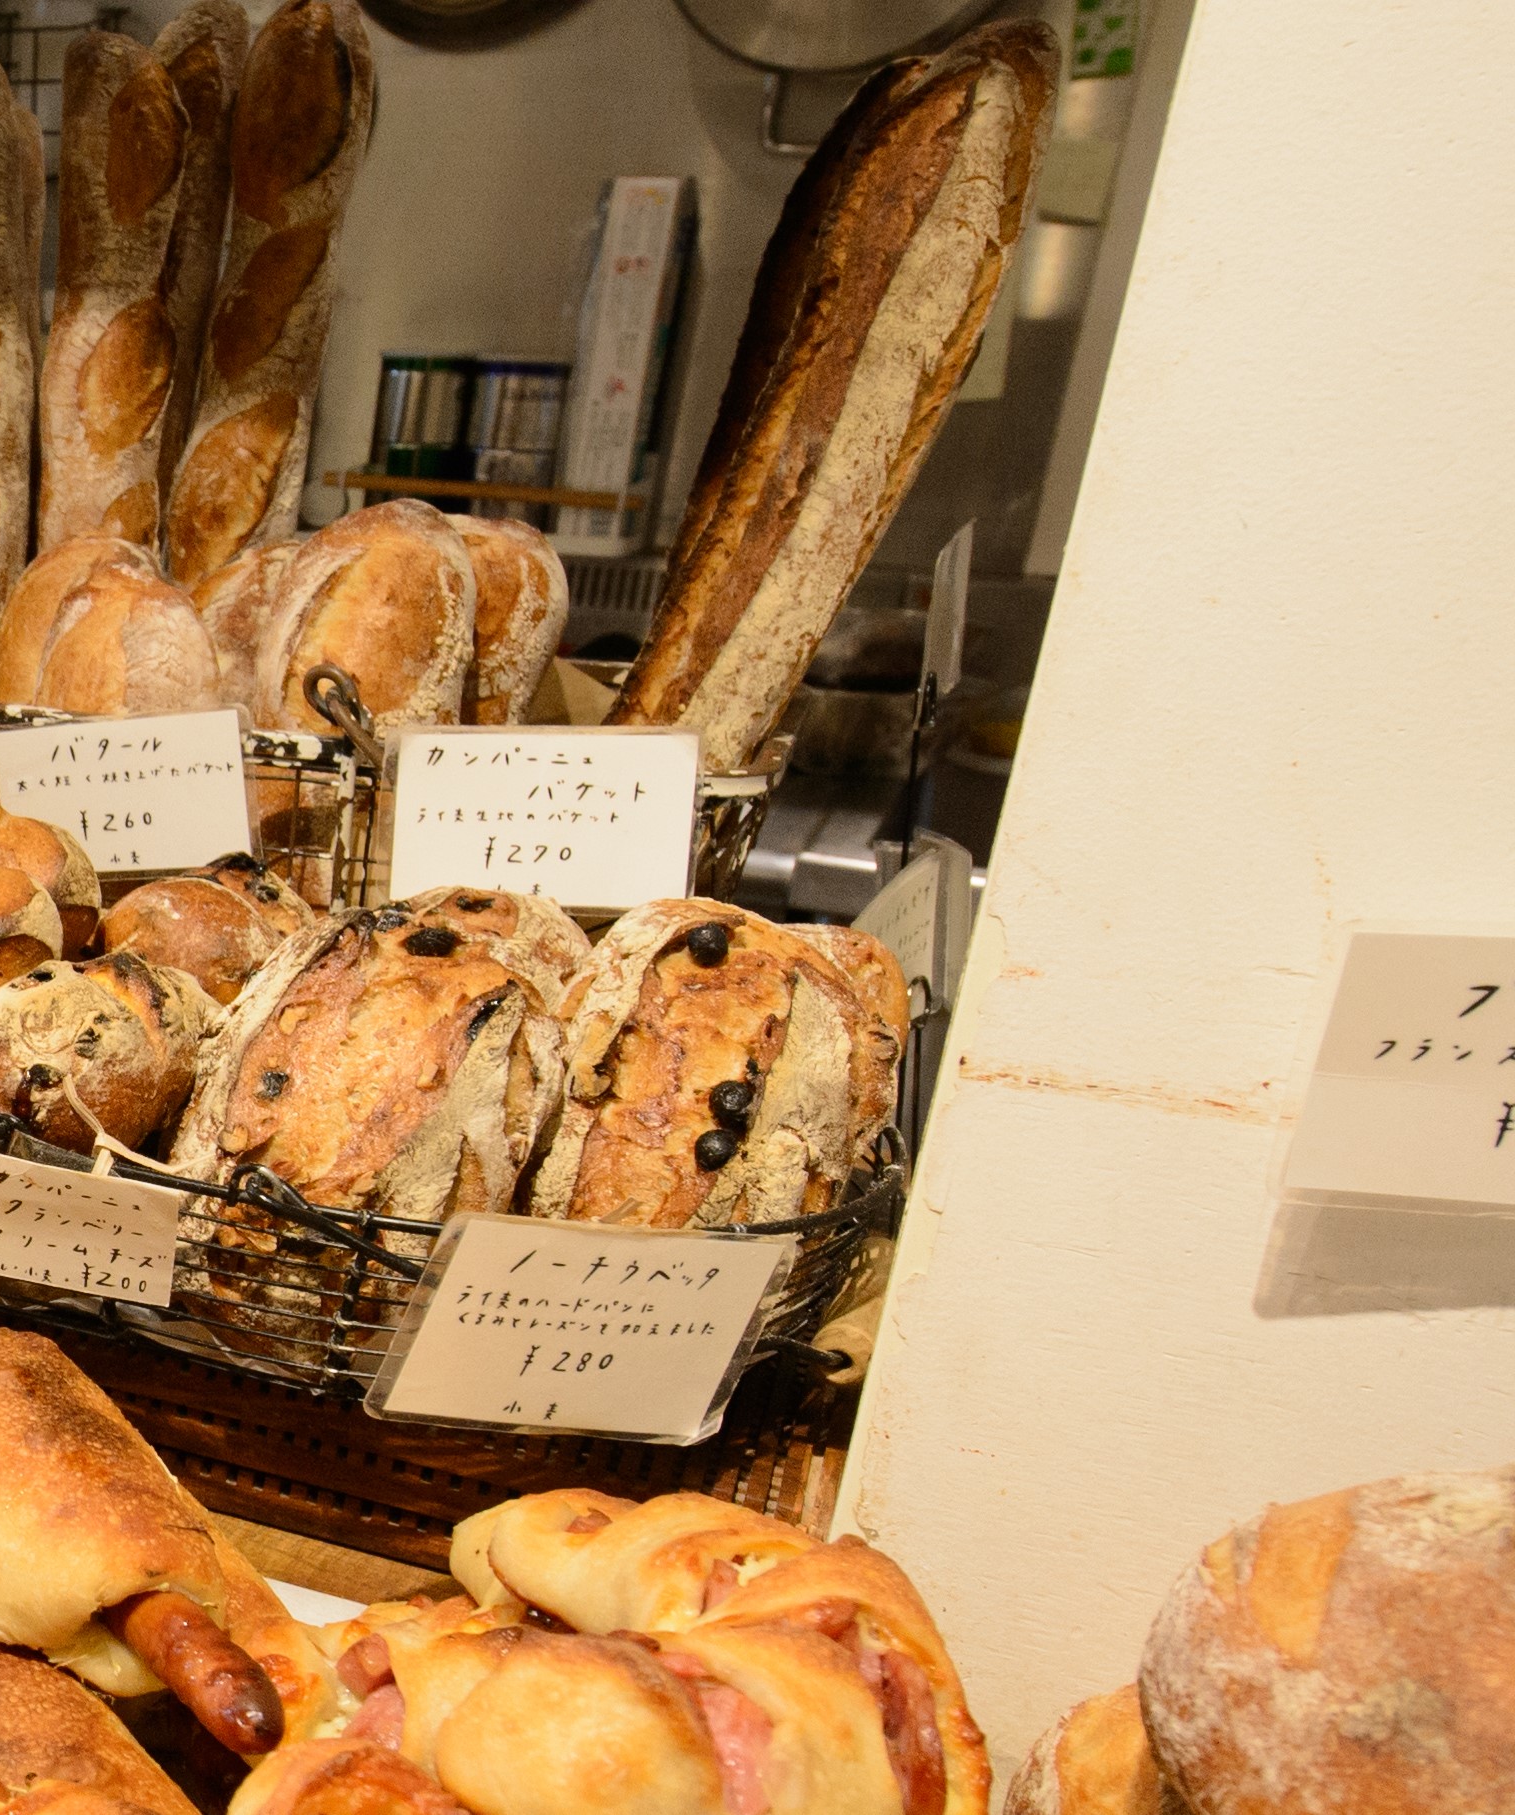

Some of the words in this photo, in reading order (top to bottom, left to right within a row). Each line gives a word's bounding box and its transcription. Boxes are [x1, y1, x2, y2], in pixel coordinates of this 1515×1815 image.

[51, 736, 163, 763] バタール
[427, 746, 593, 766] カンパーニュ
[17, 762, 235, 792] 太く短く焼き上げたバケット
[527, 780, 646, 802] バケット
[79, 810, 152, 841] ¥260
[418, 807, 619, 823] ライ麦生地のバケット
[110, 851, 140, 864] 小麦
[485, 836, 572, 869] ¥270
[4, 1200, 143, 1236] クランベリー
[81, 1262, 147, 1293] ¥200
[457, 1285, 655, 1313] ライ麦のハードパンに
[458, 1312, 715, 1336] くるみとレーズンを加えました
[519, 1345, 614, 1377] ¥280
[503, 1400, 558, 1420] 小麦
